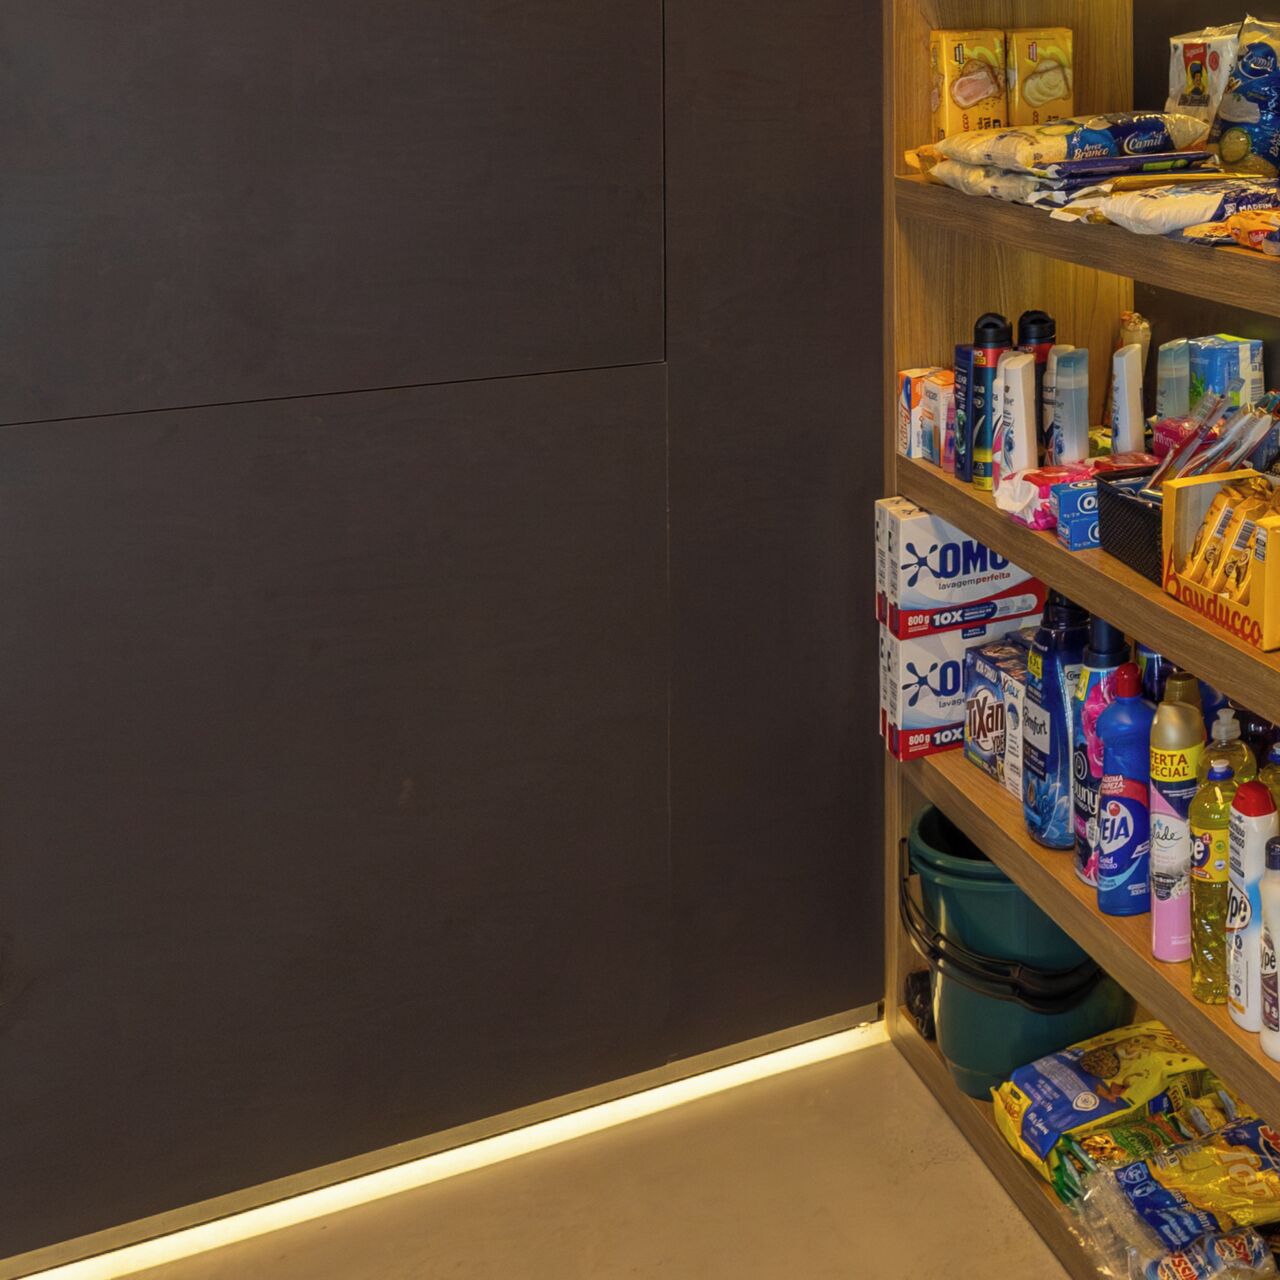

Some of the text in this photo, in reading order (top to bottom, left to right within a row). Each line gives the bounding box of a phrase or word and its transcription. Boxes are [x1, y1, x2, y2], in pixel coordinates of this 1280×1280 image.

[1128, 132, 1163, 150] Camil
[1074, 147, 1109, 161] Branco
[933, 611, 963, 627] 10X
[933, 728, 963, 745] 10X
